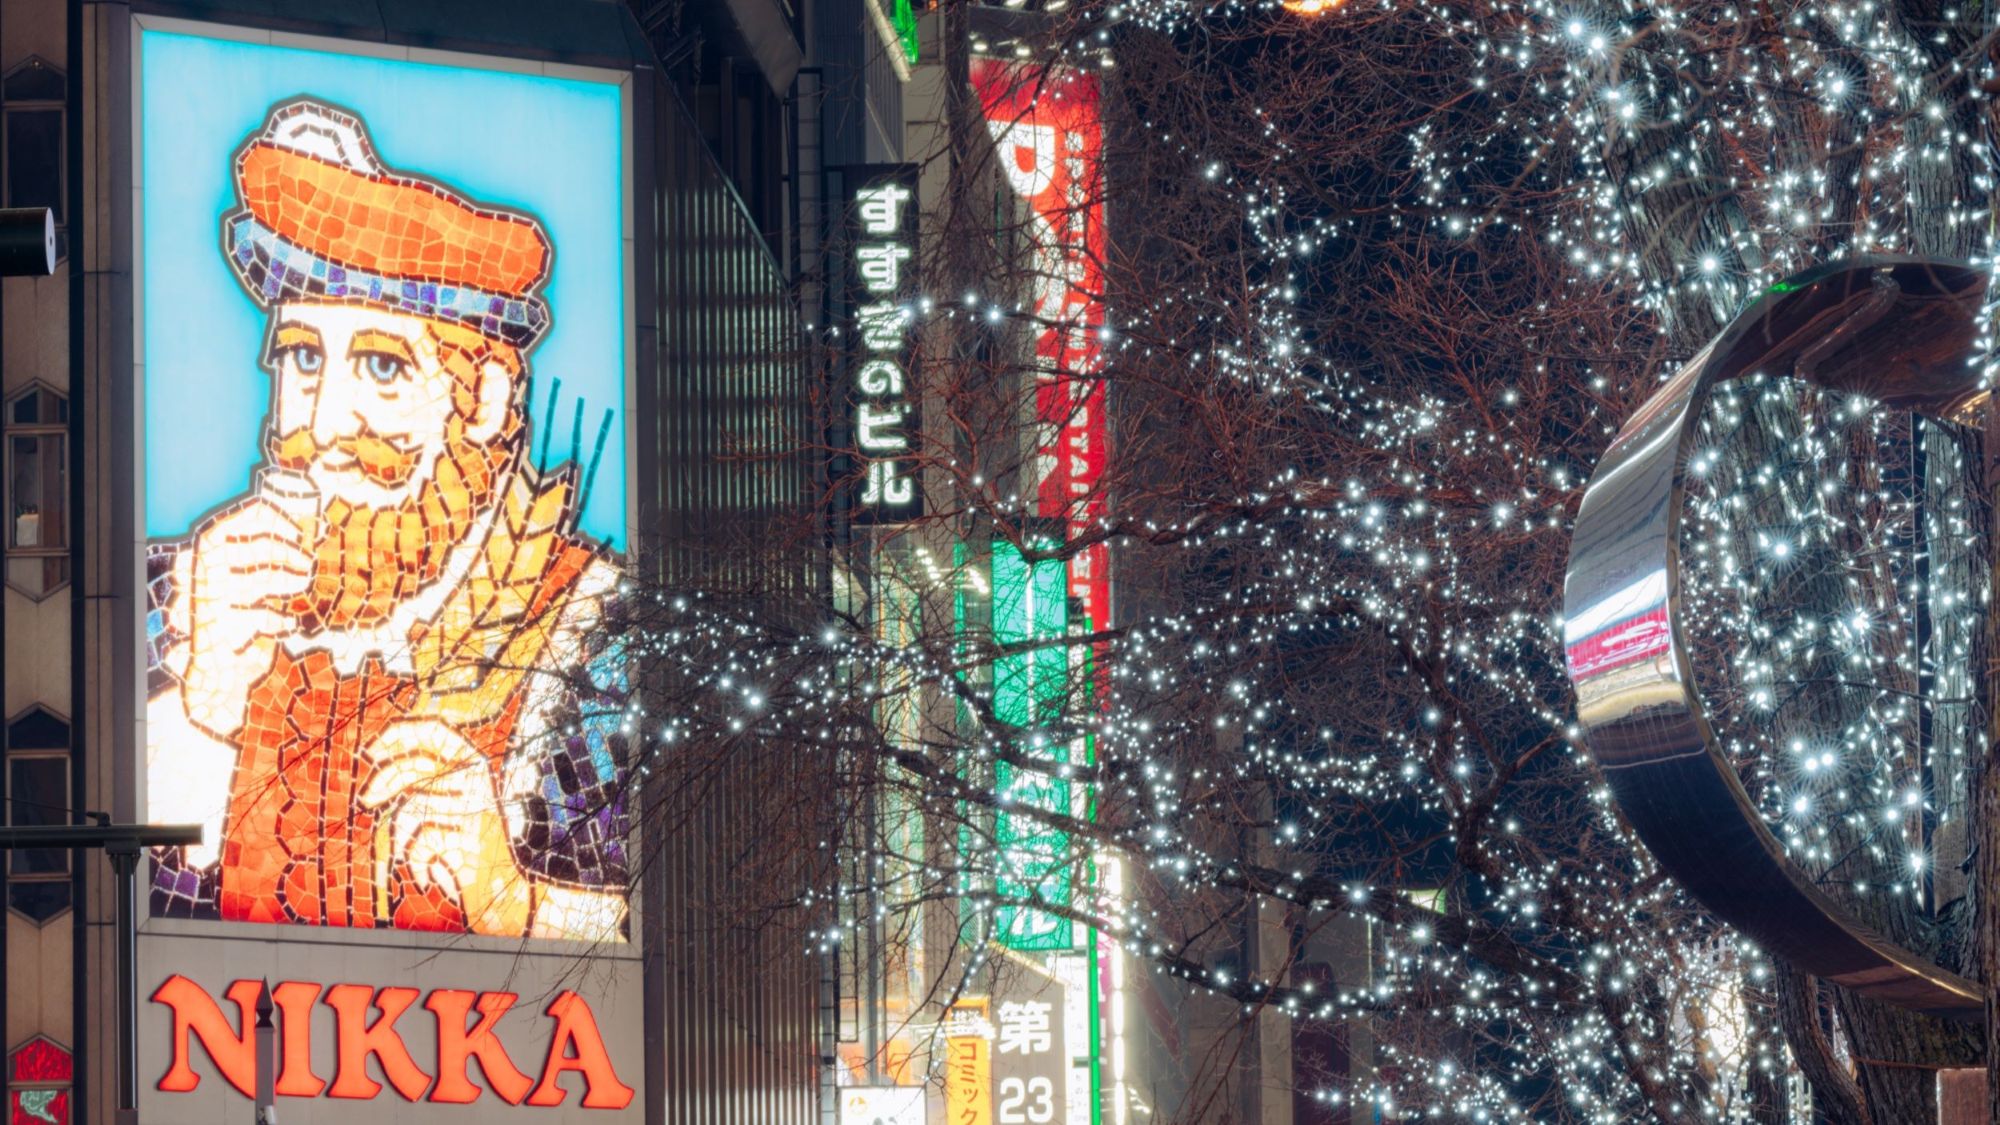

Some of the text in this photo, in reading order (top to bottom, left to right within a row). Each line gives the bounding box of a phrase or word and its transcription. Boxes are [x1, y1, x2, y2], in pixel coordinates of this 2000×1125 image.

[856, 183, 912, 504] すすきのビル
[1066, 303, 1092, 618] ENTERTAINEN
[150, 974, 635, 1110] NIKKA
